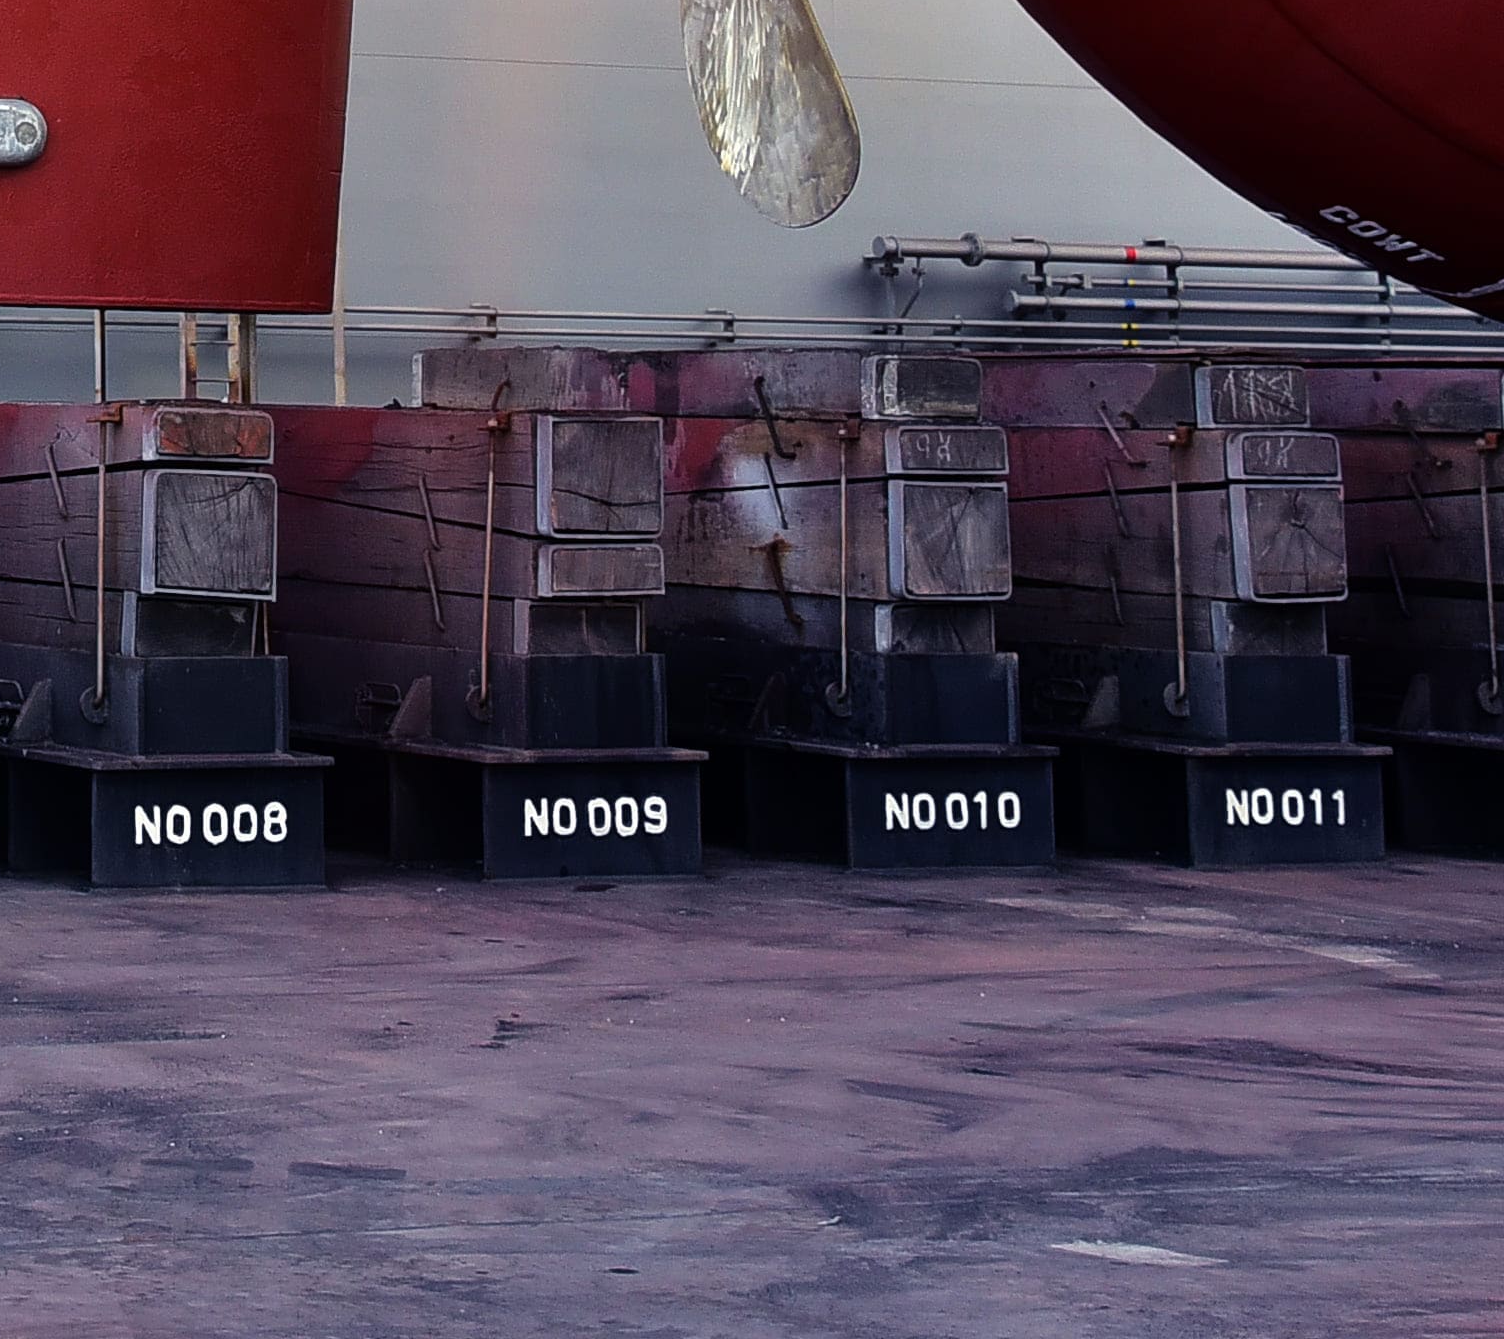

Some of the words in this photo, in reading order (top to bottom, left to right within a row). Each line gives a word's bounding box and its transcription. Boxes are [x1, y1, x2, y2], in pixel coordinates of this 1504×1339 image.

[134, 804, 192, 845] NO
[202, 801, 288, 846] 008
[524, 797, 577, 837] NO
[587, 795, 668, 837] 009
[885, 792, 936, 831] NO
[945, 790, 1021, 830] 010
[1225, 787, 1274, 826] NO
[1281, 788, 1346, 826] 011
